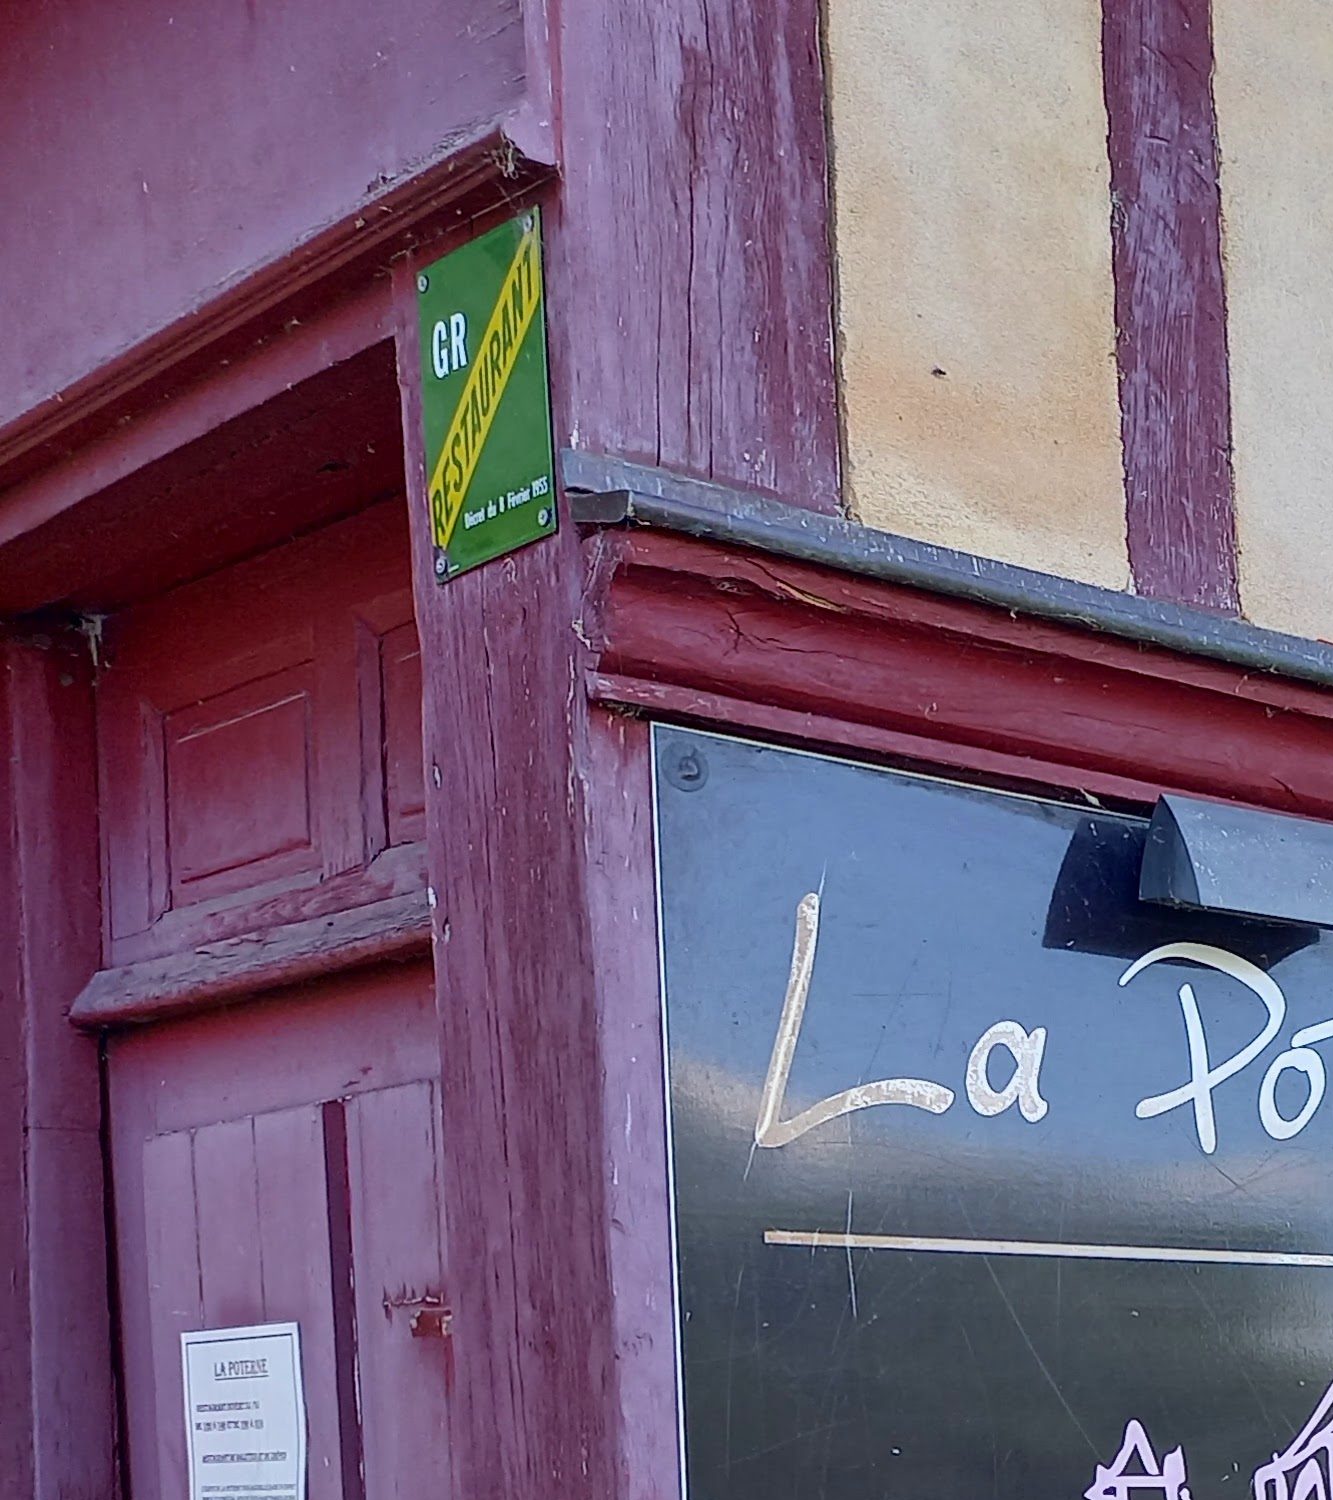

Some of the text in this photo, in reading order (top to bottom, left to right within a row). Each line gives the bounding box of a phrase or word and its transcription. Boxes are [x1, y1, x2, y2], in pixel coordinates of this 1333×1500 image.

[432, 312, 469, 380] GR
[432, 244, 536, 547] RESTAURANT
[487, 500, 497, 518] du
[507, 487, 531, 509] Février
[532, 476, 549, 497] 1955
[756, 893, 1048, 1148] La
[214, 1358, 268, 1377] LA POTERNE
